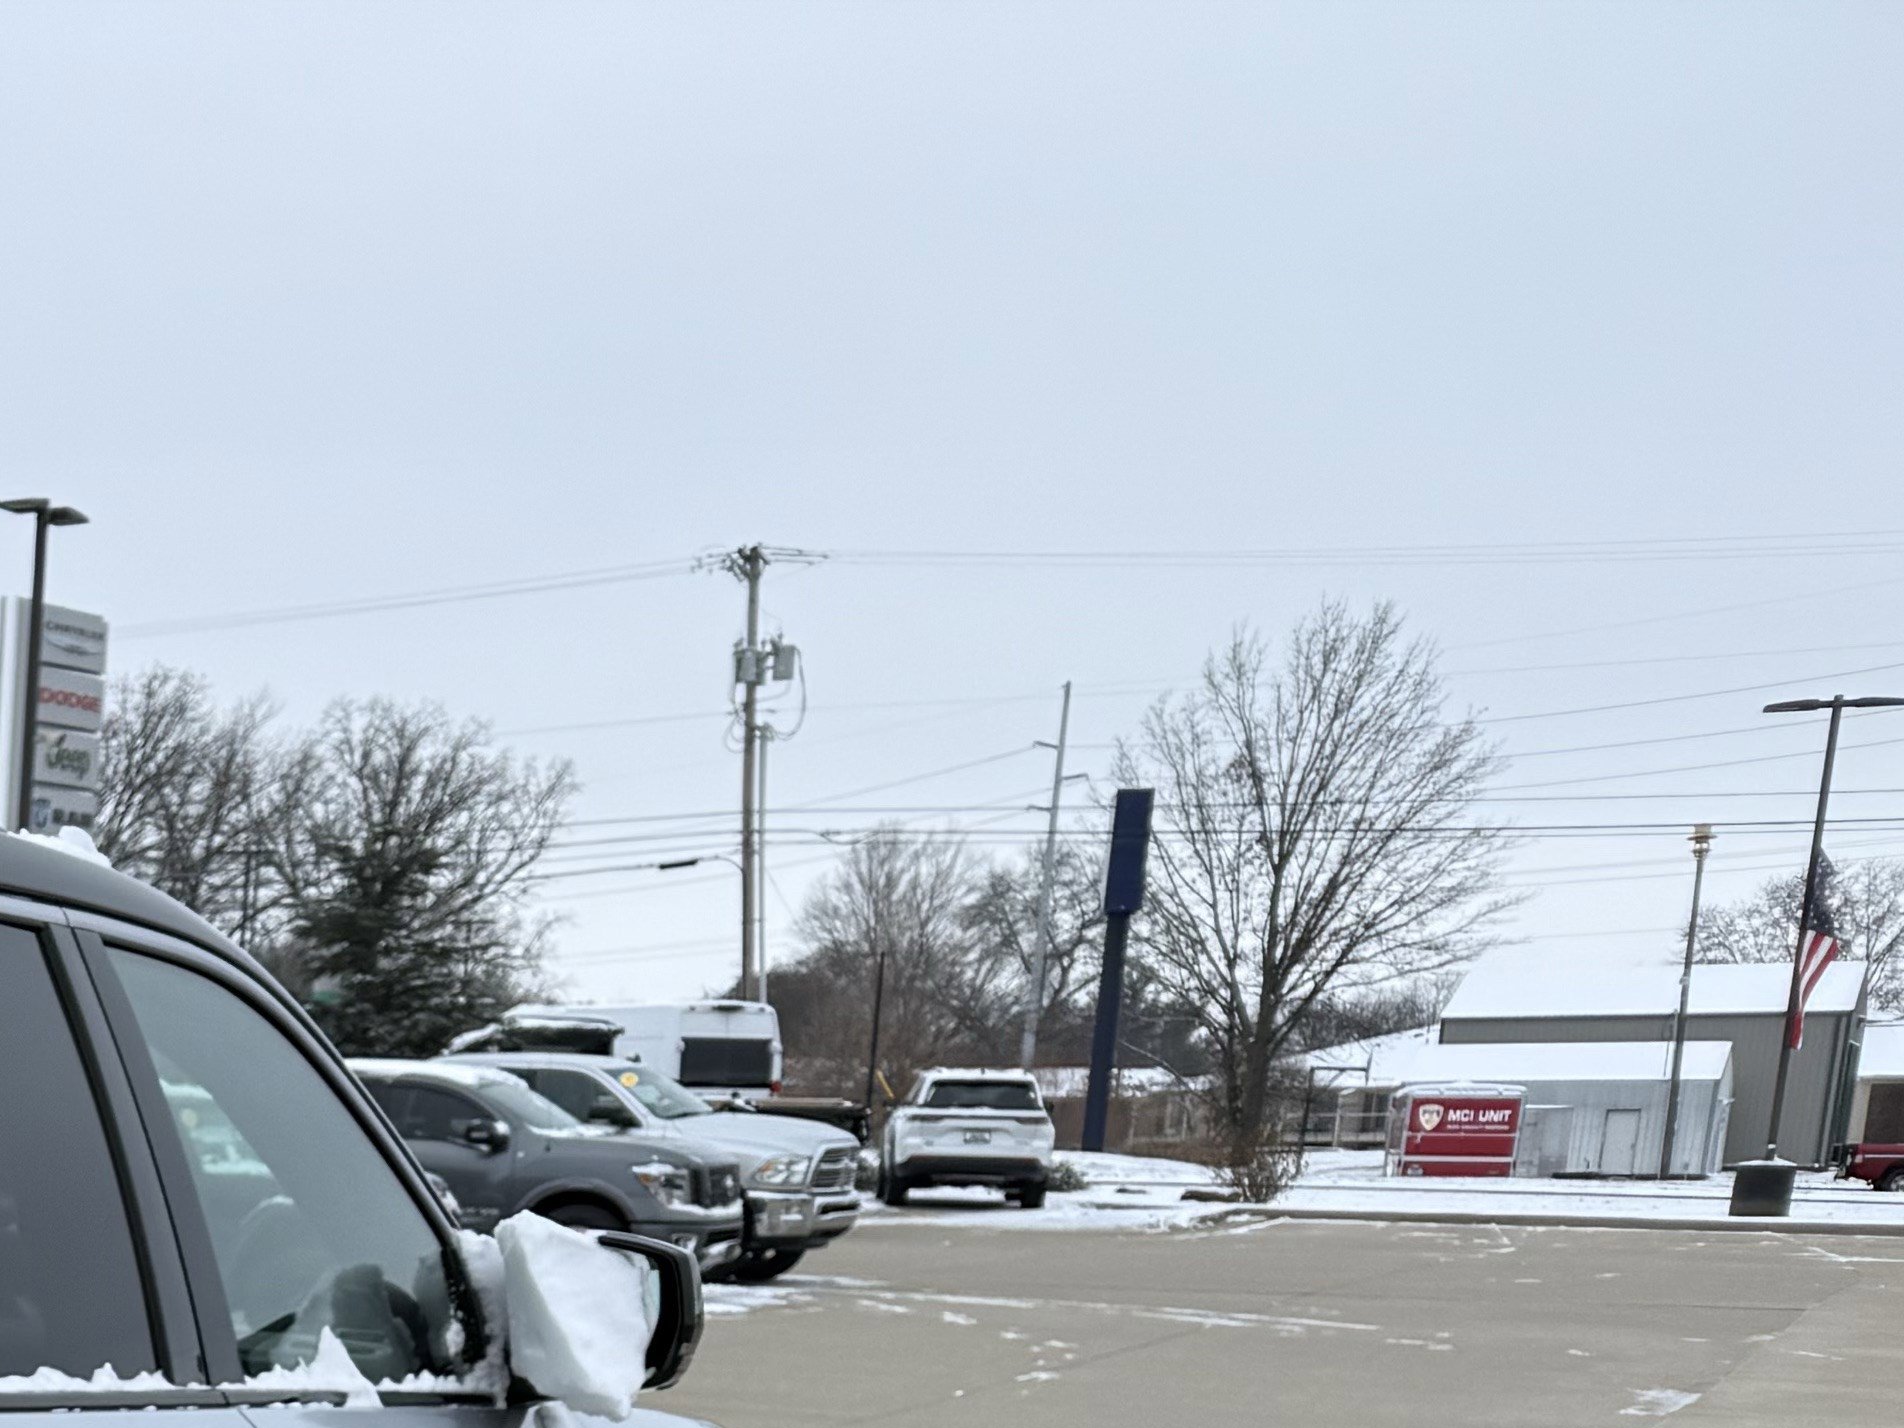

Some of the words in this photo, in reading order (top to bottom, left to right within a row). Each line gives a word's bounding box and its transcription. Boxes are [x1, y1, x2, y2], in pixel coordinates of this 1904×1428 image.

[38, 686, 101, 713] DODGE
[1447, 1108, 1475, 1122] MCI
[1478, 1109, 1512, 1122] UNIT
